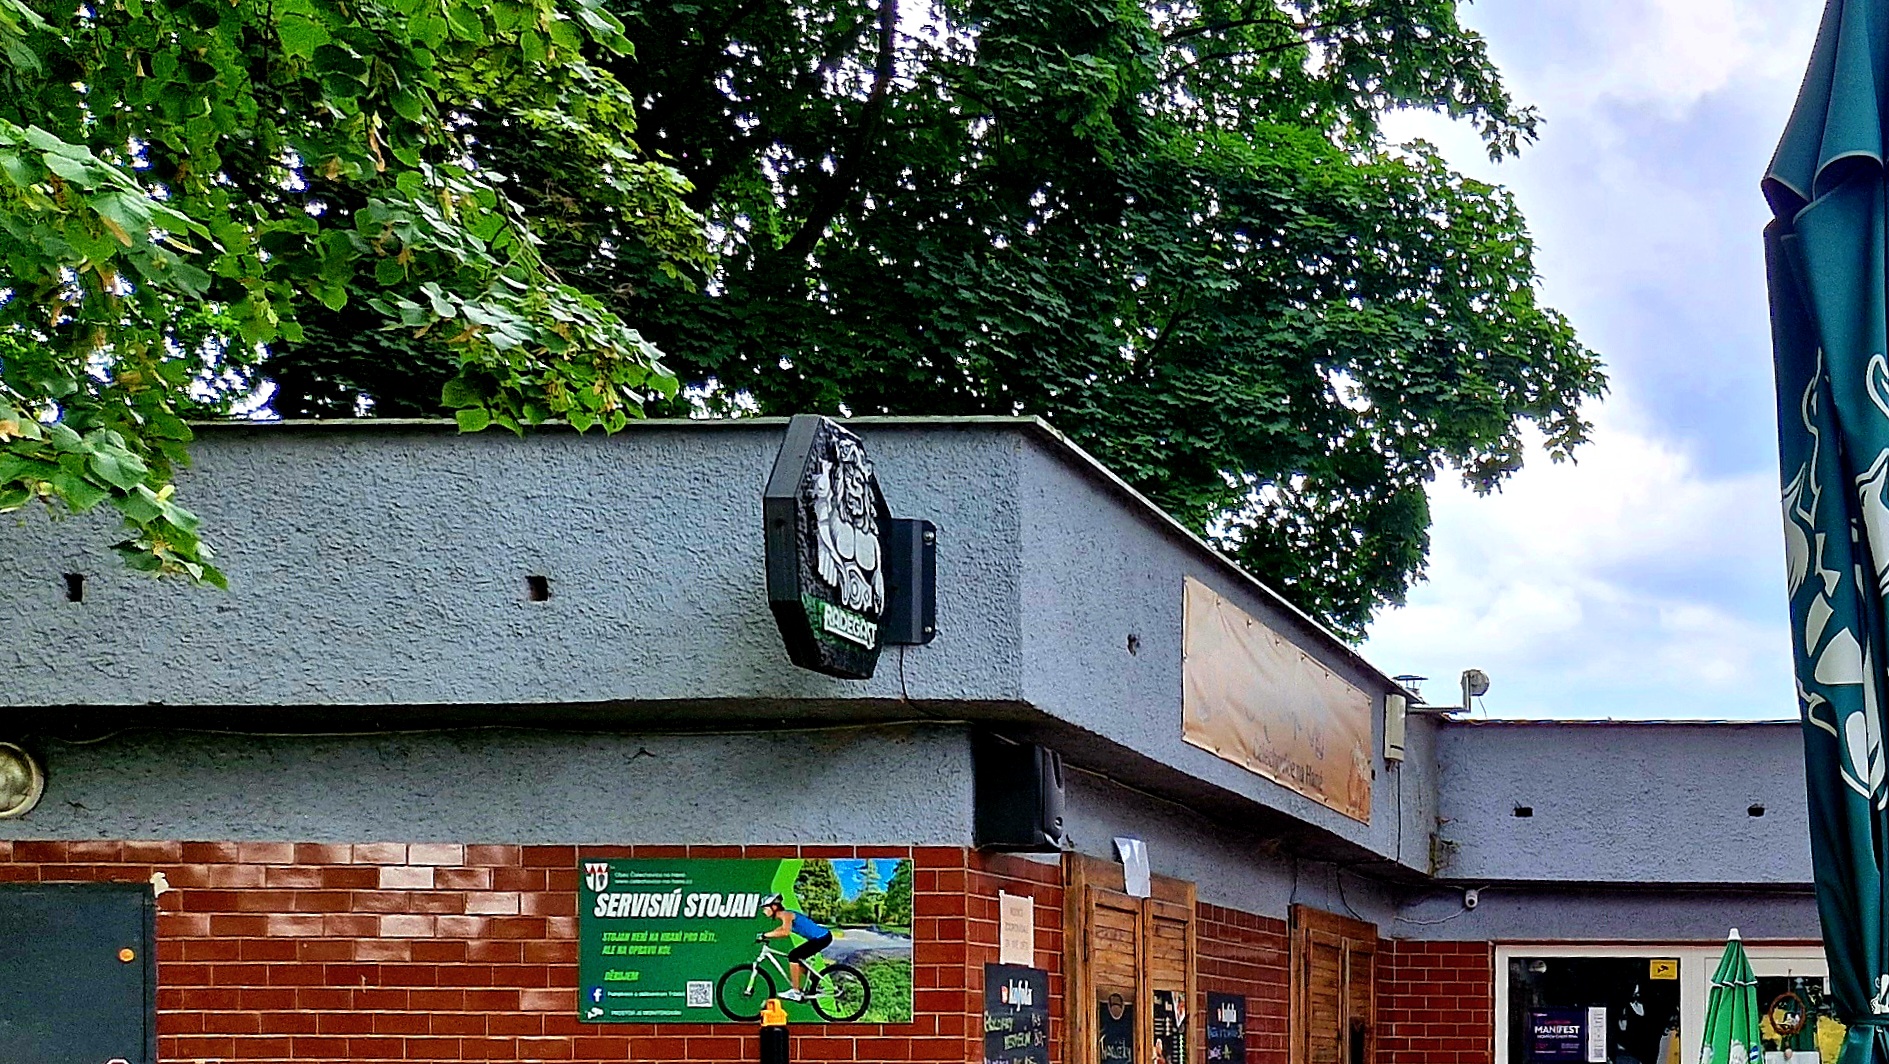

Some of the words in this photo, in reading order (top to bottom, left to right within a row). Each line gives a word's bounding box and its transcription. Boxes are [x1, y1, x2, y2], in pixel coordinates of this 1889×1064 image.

[823, 603, 878, 646] RADEGAST
[593, 888, 683, 918] SERVISNÍ
[683, 893, 761, 918] STOJAN
[1534, 1025, 1580, 1034] MANIFEST
